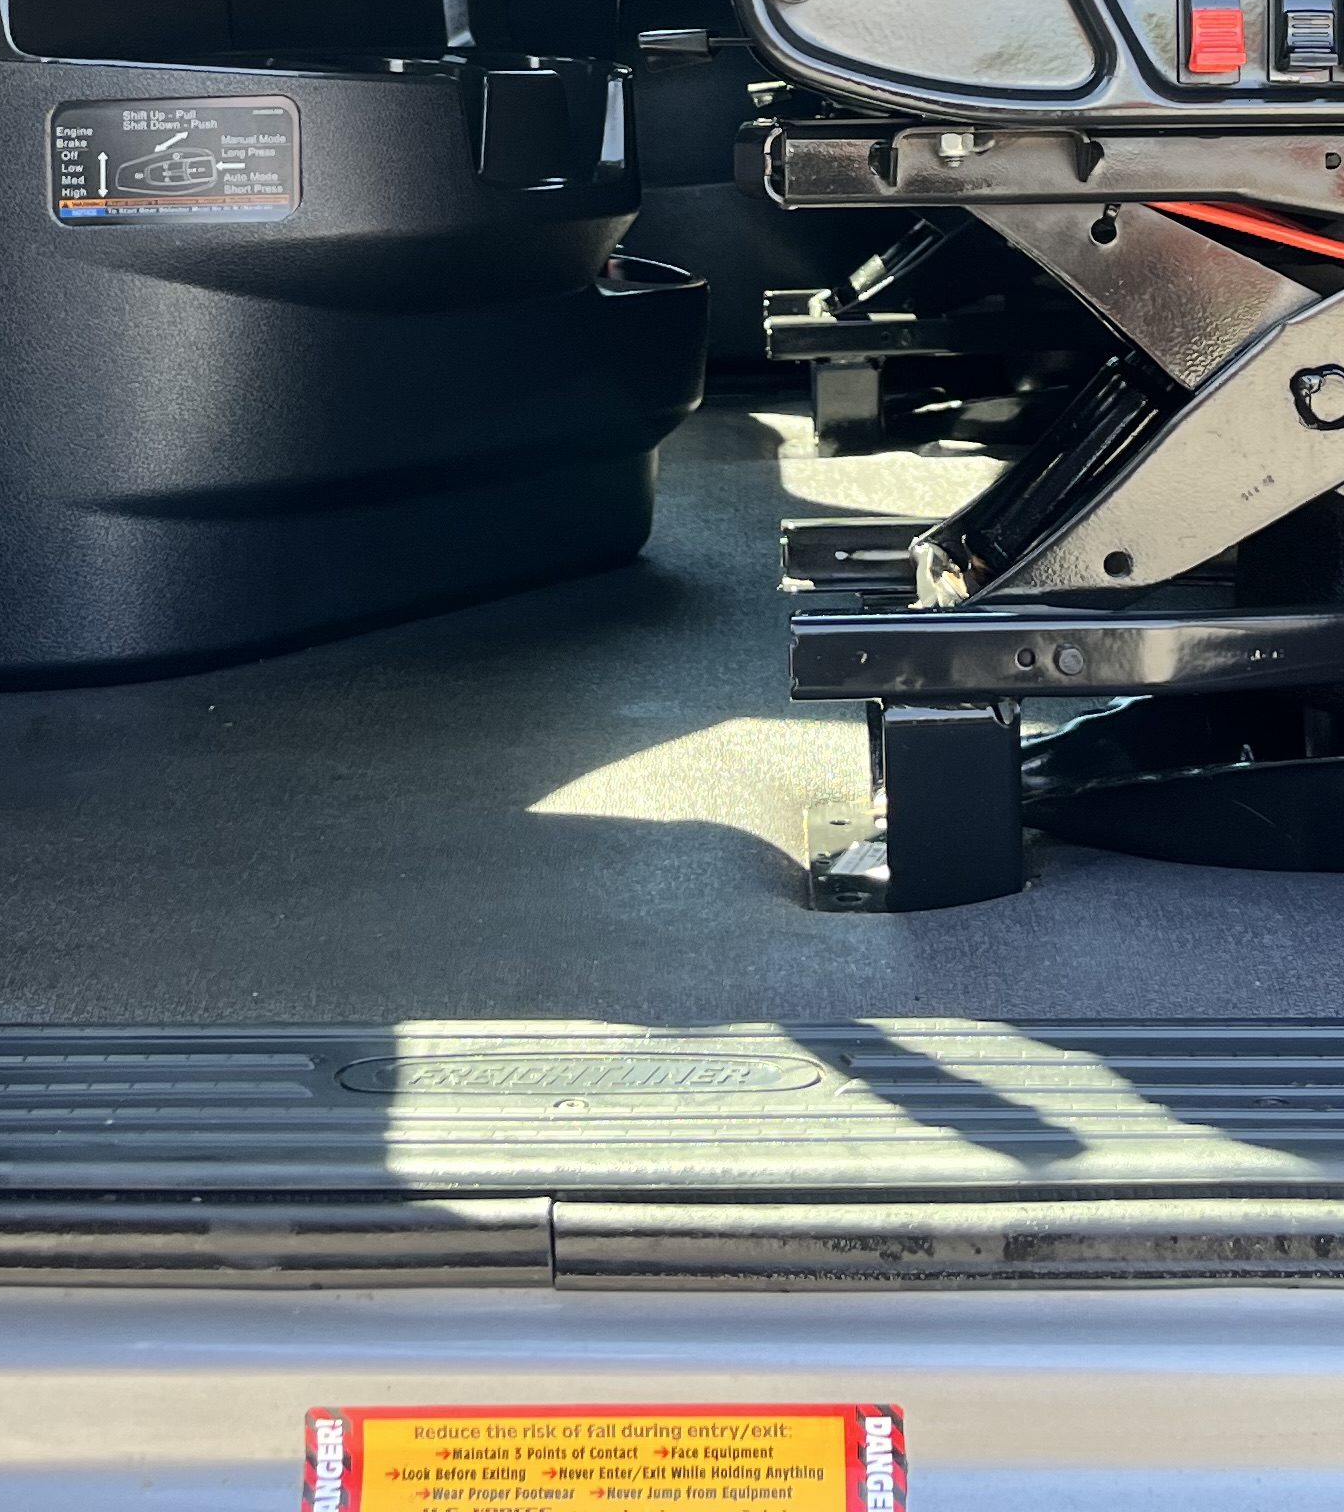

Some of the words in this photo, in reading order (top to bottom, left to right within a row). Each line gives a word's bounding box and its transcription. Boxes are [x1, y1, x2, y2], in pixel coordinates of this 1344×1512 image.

[123, 110, 148, 121] Shift
[150, 111, 166, 122] Up
[175, 109, 197, 120] Pull
[123, 120, 148, 130] Shift
[150, 120, 181, 130] Down
[190, 119, 218, 130] Push
[56, 126, 93, 139] Engine
[56, 138, 88, 148] Brake
[221, 134, 257, 145] Manual
[259, 133, 287, 144] Mode
[61, 151, 78, 161] Off
[221, 148, 246, 159] Long
[247, 147, 276, 158] Press
[61, 163, 84, 173] Low
[61, 175, 85, 185] Med
[223, 171, 250, 183] Auto
[251, 171, 279, 182] Mode
[61, 187, 87, 198] High
[223, 184, 251, 195] Short
[252, 183, 284, 194] Press
[408, 1060, 754, 1086] FREIGHTLINER
[414, 1424, 481, 1439] Reduce
[486, 1423, 519, 1438] the
[523, 1423, 558, 1438] risk
[562, 1423, 583, 1438] of
[586, 1423, 616, 1438] fall
[621, 1423, 682, 1440] during
[452, 1446, 509, 1460] Maintain
[527, 1446, 567, 1460] Points
[572, 1445, 585, 1459] of
[589, 1445, 638, 1459] Contact
[671, 1445, 699, 1459] Face
[704, 1445, 774, 1461] Equipment
[402, 1466, 431, 1481] Look
[436, 1466, 477, 1481] Before
[482, 1466, 526, 1482] Exiting
[559, 1466, 594, 1480] Never
[599, 1465, 666, 1482] Enter/Exit
[671, 1465, 706, 1480] While
[711, 1465, 761, 1481] Holding
[766, 1465, 824, 1481] Anything
[432, 1487, 463, 1500] Wear
[468, 1487, 510, 1502] Proper
[515, 1486, 575, 1500] Footwear
[606, 1487, 643, 1500] Never
[647, 1486, 682, 1502] Jump
[686, 1485, 716, 1499] from
[721, 1486, 794, 1502] Equipment
